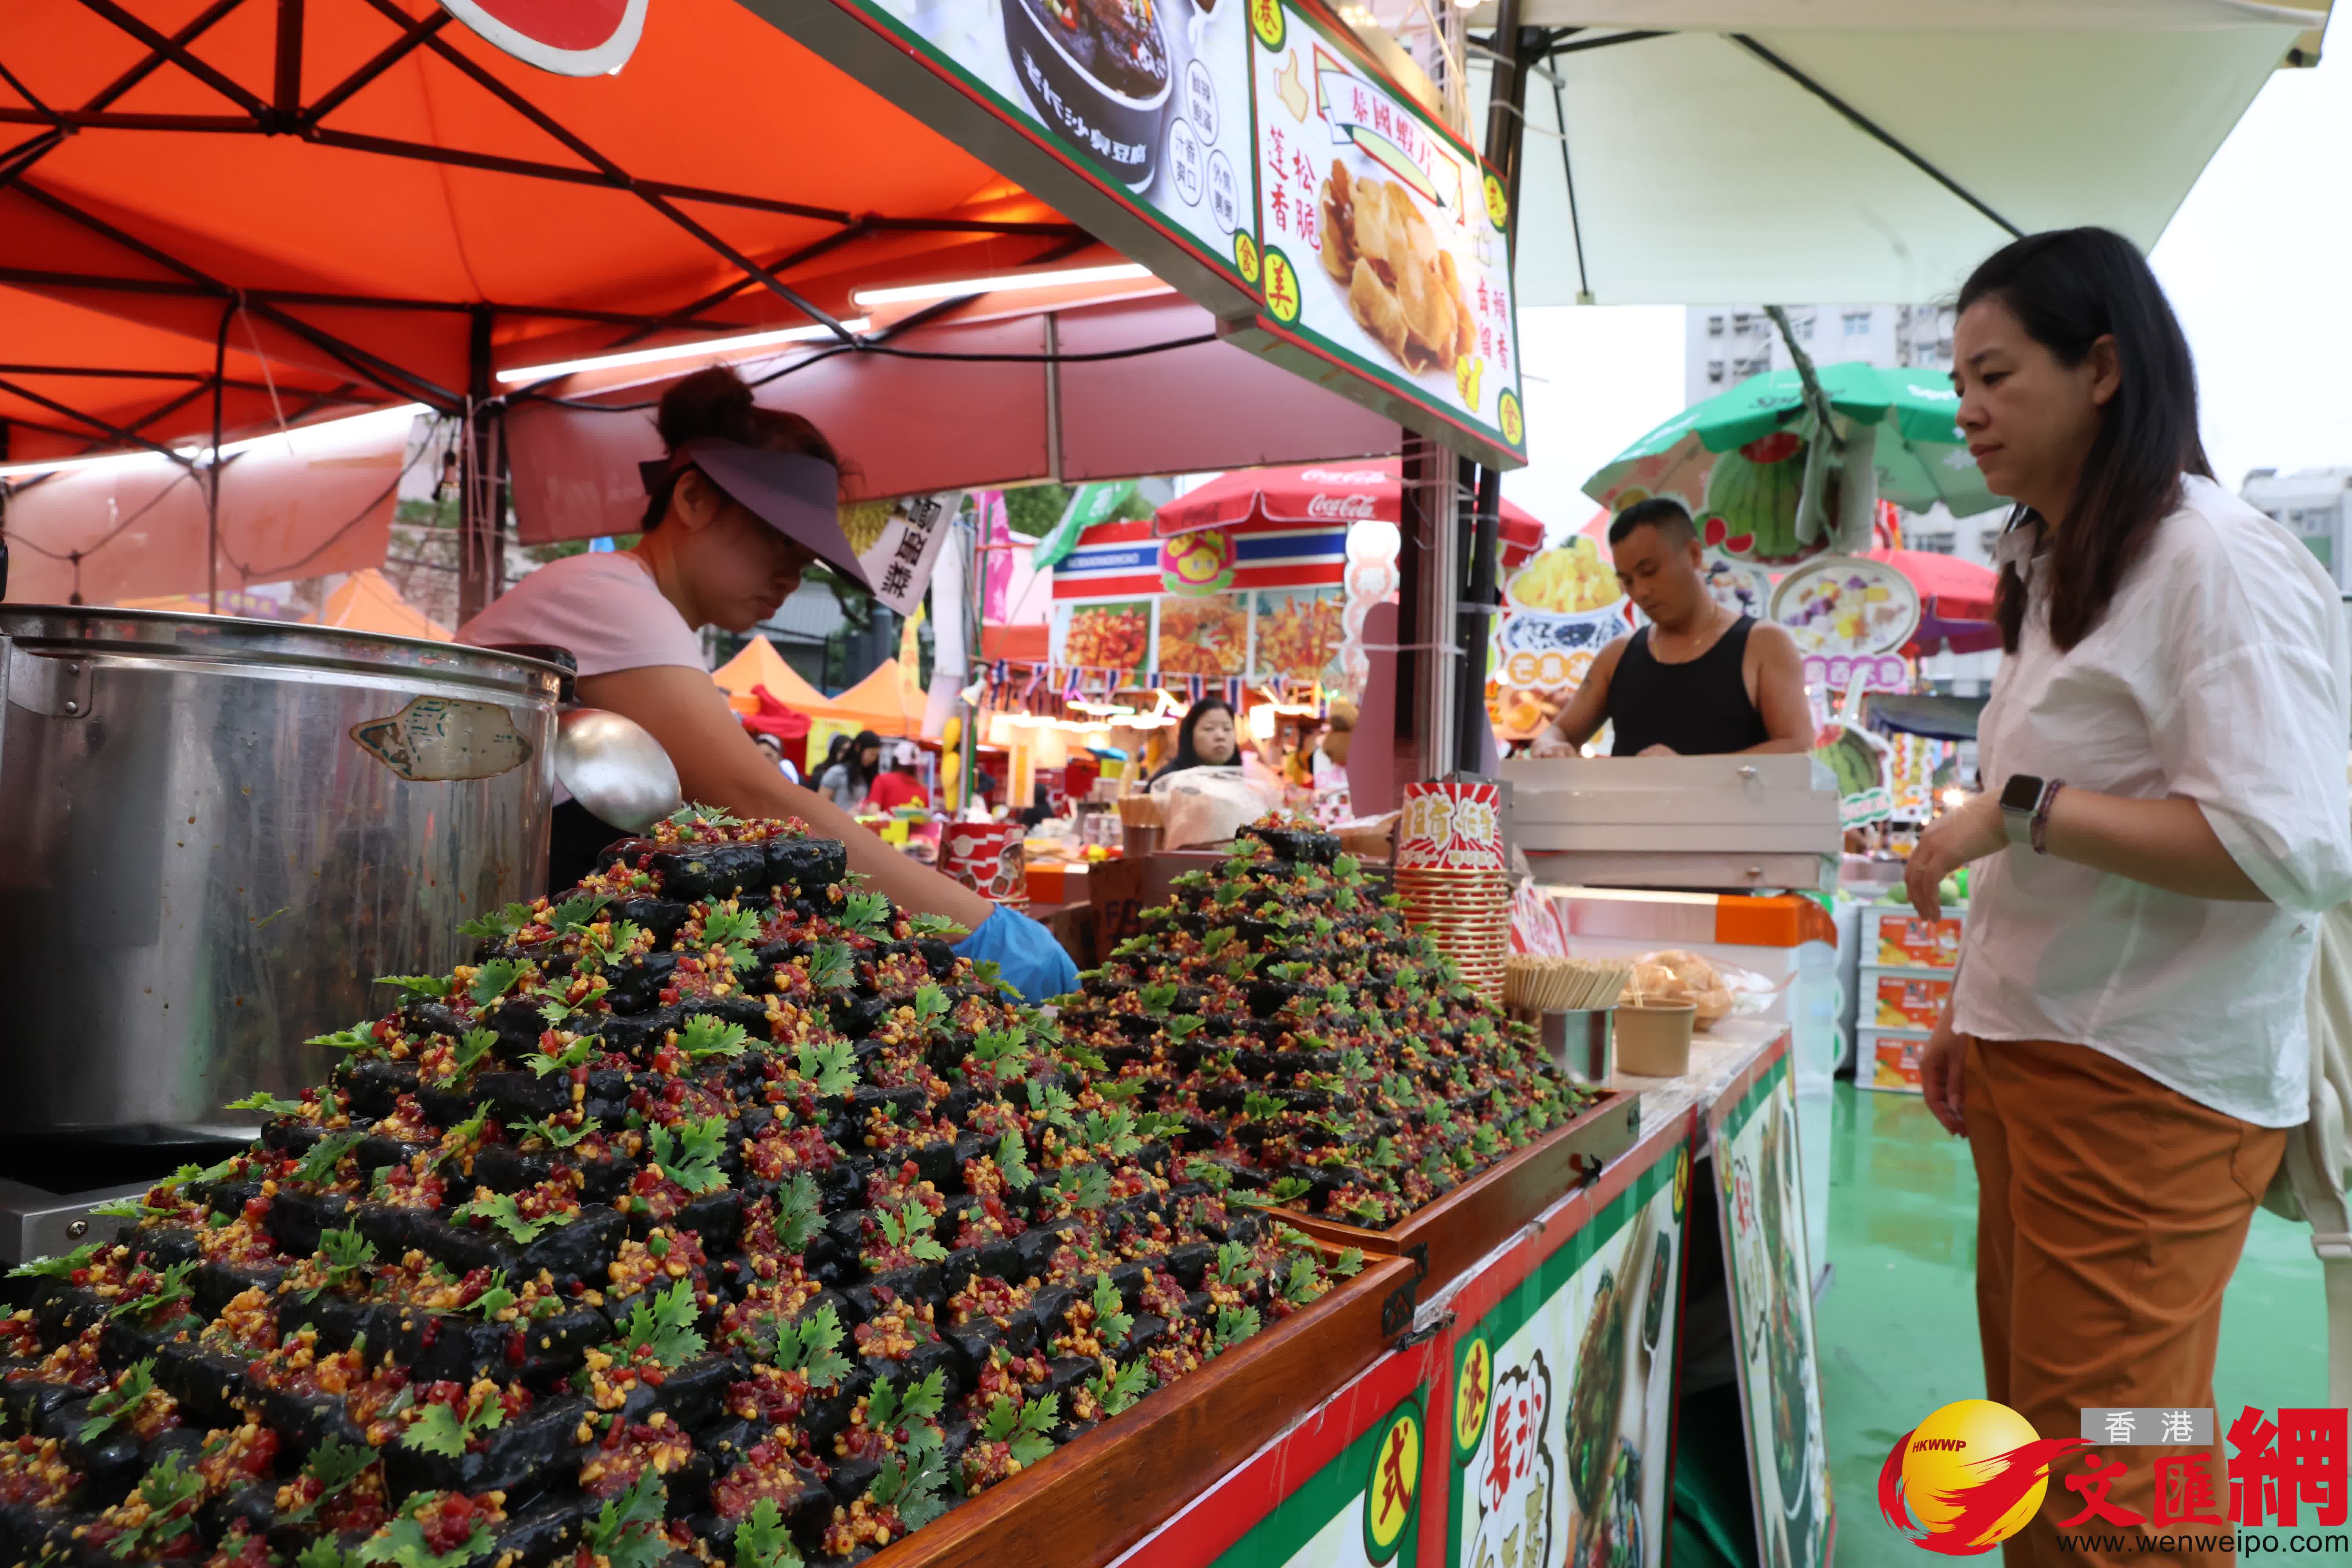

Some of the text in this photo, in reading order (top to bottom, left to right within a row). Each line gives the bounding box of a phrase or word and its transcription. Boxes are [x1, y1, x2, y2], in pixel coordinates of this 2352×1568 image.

[1352, 85, 1433, 179] 泰國蝦片
[1239, 238, 1256, 277] 食
[1268, 257, 1293, 318] 美
[1461, 1344, 1486, 1436] 港
[1379, 1421, 1412, 1526] 式
[1486, 1377, 1542, 1512] 長沙
